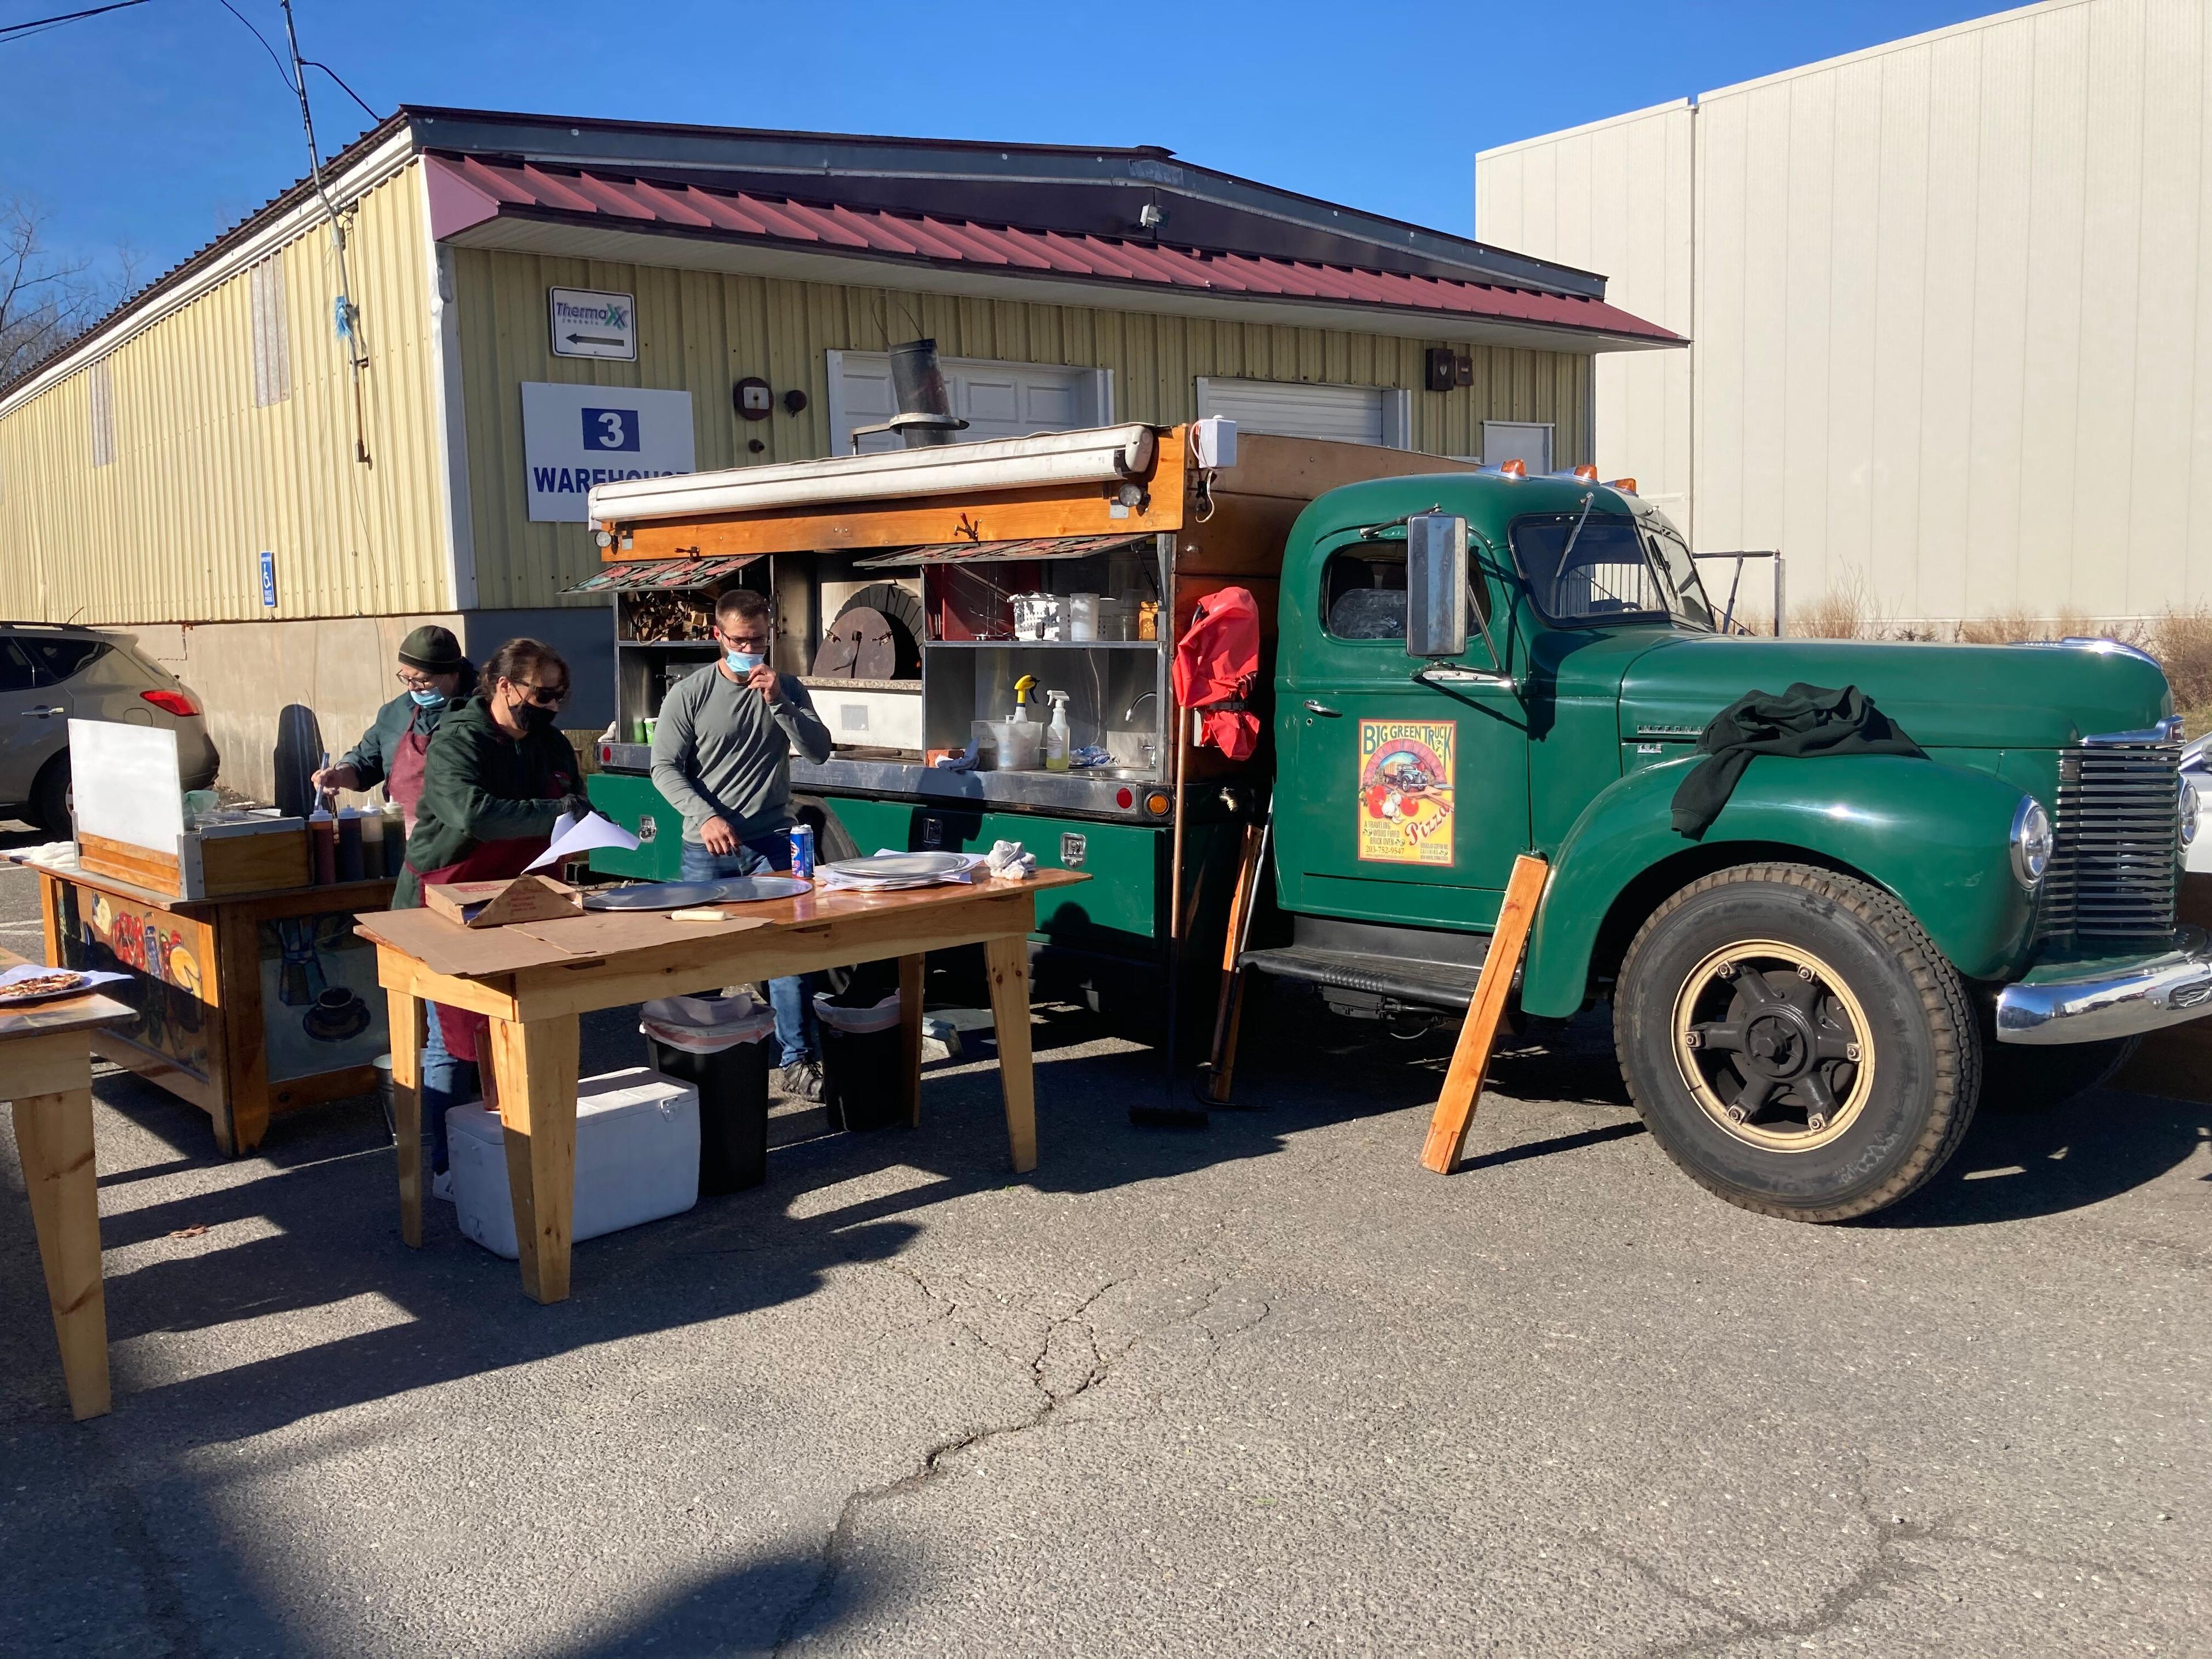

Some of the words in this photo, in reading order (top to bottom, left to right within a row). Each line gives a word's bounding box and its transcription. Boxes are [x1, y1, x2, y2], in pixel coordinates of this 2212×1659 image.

[598, 412, 624, 448] 3
[1363, 725, 1387, 755] BIG
[1390, 725, 1421, 739] GREEN
[1422, 726, 1453, 772] TRUCK
[1404, 804, 1449, 846] Pizza
